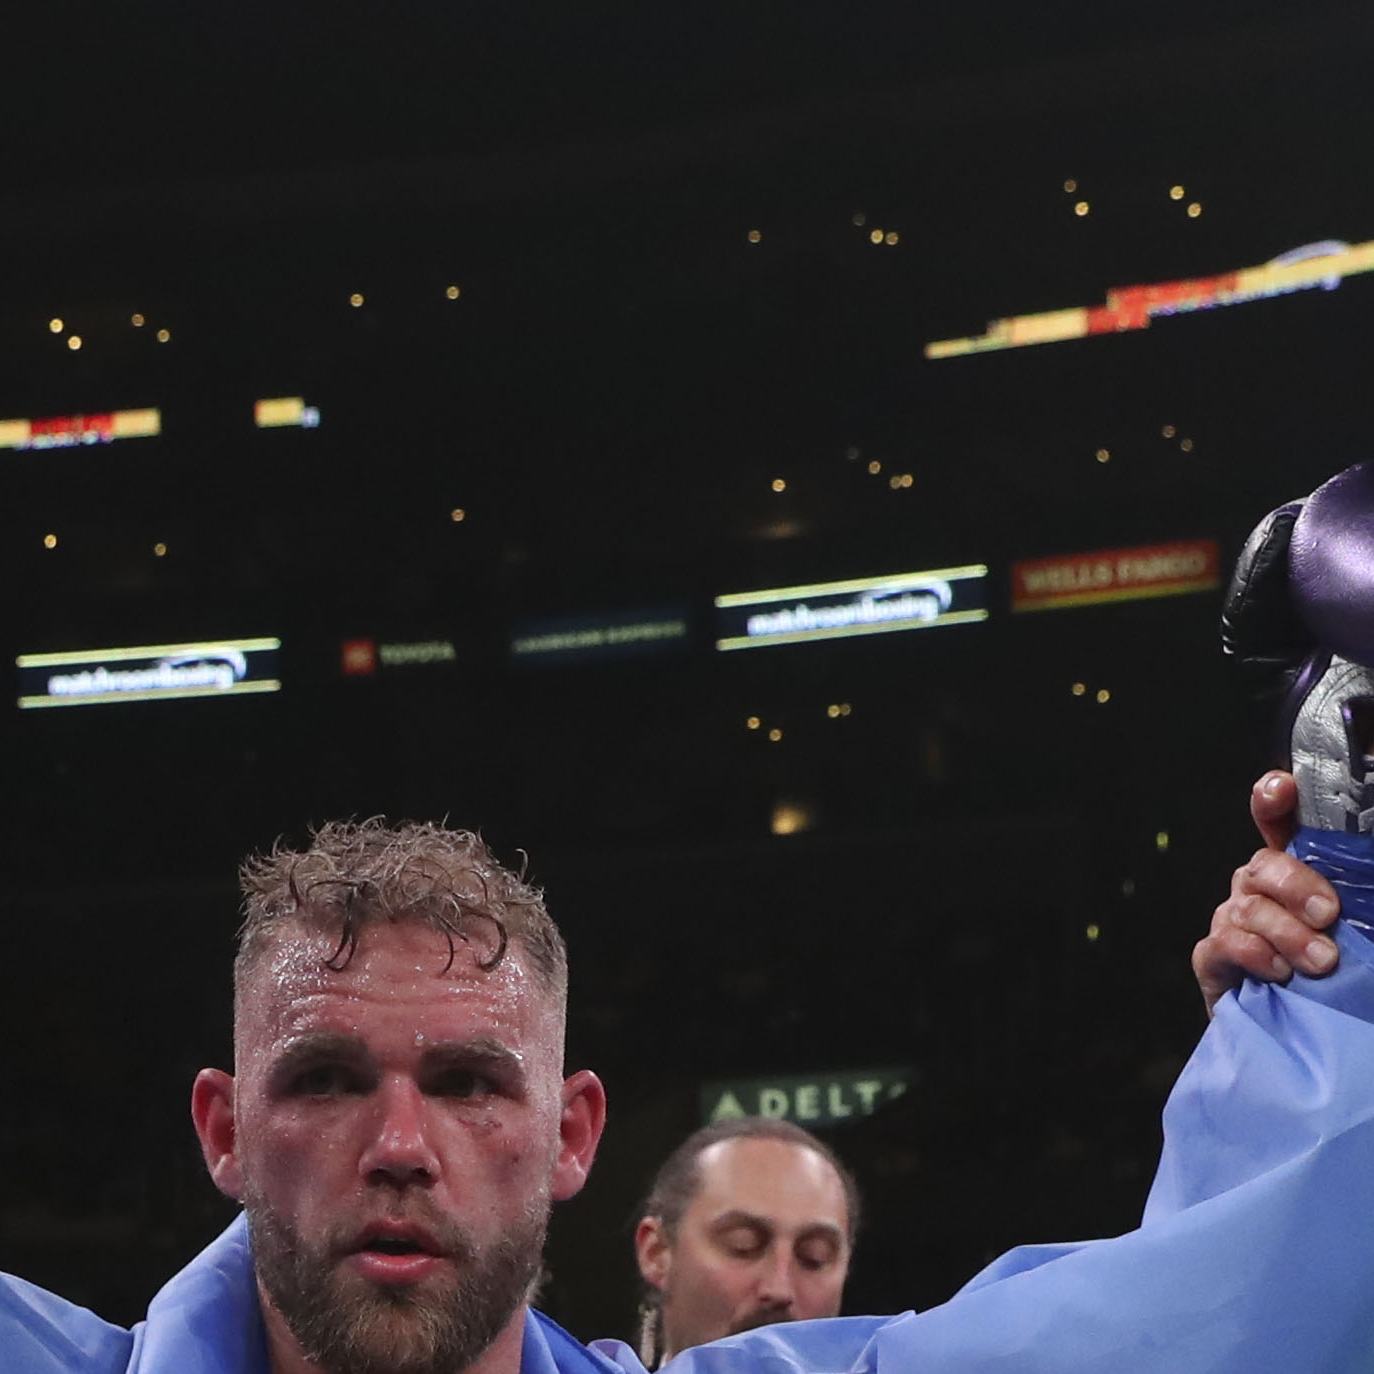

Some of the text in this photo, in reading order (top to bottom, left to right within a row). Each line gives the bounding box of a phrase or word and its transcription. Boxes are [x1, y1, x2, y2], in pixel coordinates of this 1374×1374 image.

[1023, 551, 1207, 593] WELLS FARGO
[759, 1080, 908, 1120] DELT
